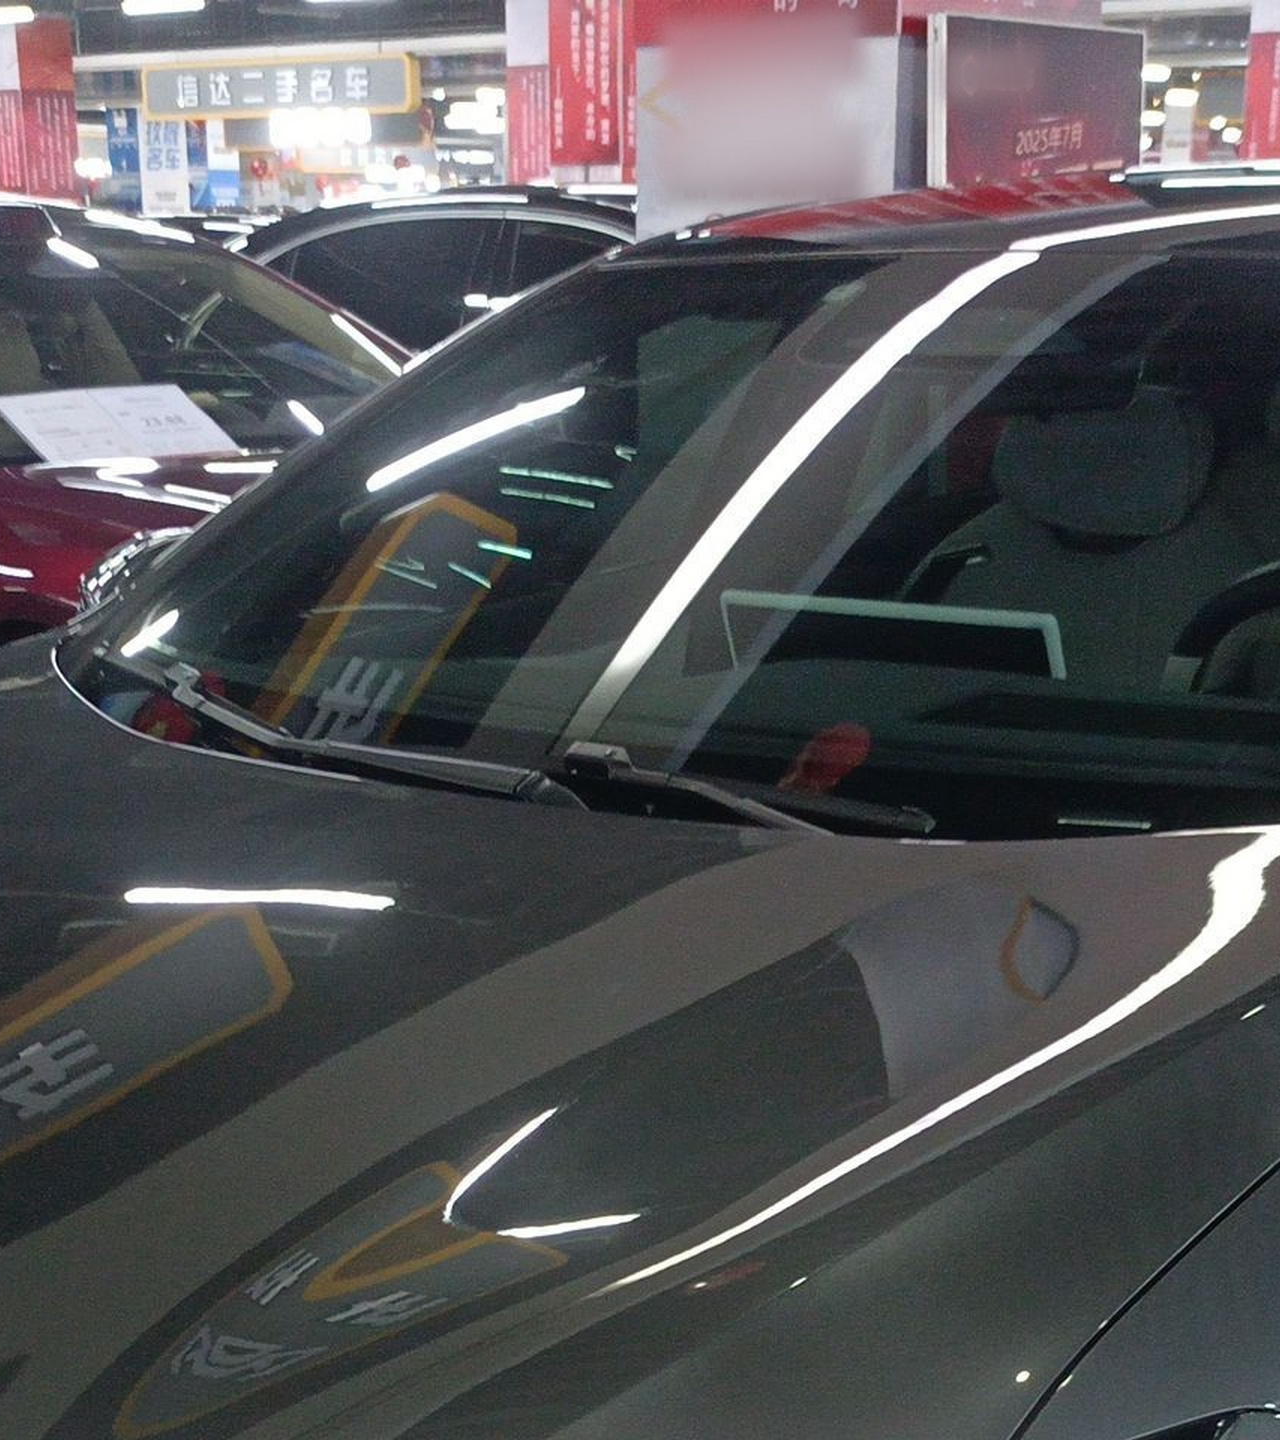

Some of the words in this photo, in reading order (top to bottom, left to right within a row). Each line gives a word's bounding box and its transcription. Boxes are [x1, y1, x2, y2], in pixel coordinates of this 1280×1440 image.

[175, 66, 369, 109] 信达二手名车
[1015, 121, 1085, 156] 2025年7月
